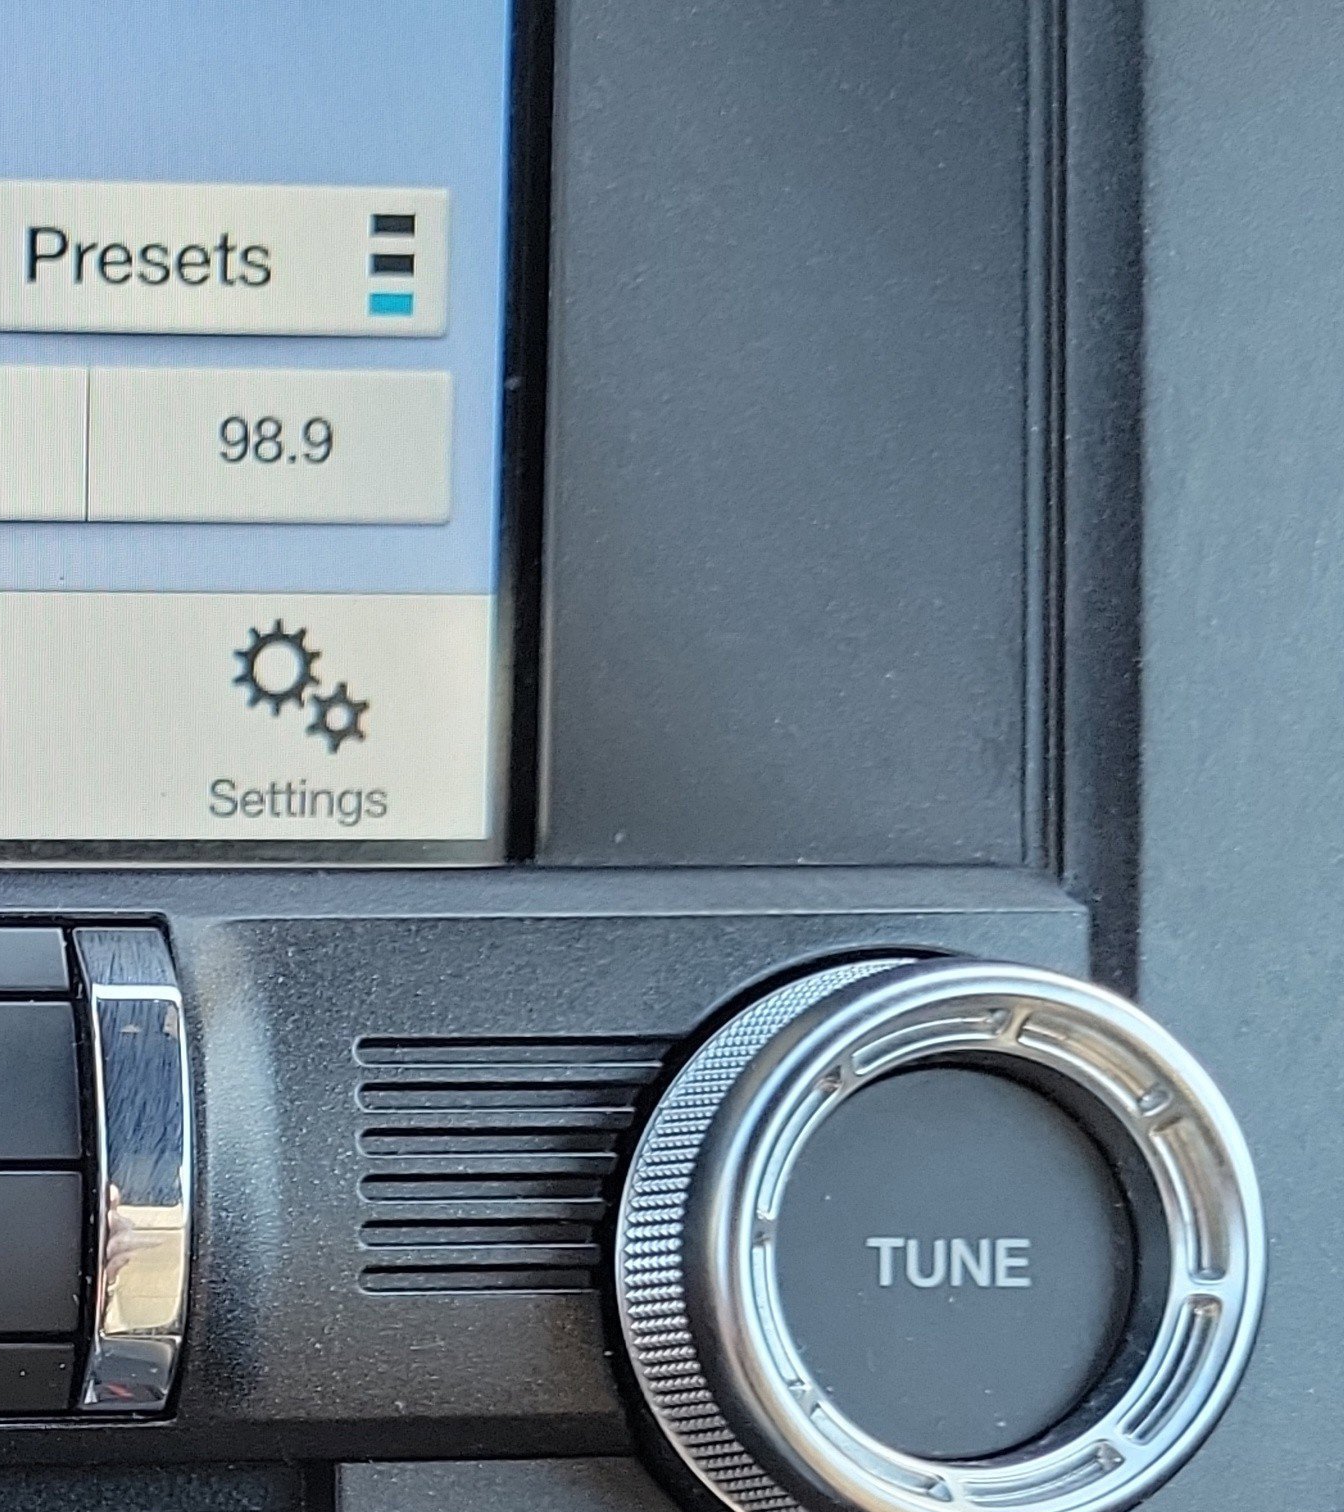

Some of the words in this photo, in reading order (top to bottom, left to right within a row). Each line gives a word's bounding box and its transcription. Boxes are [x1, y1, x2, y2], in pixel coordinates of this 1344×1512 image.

[24, 226, 273, 288] Presets
[217, 416, 334, 465] 98.9
[208, 779, 388, 828] Settings
[867, 1237, 1031, 1288] TUNE
